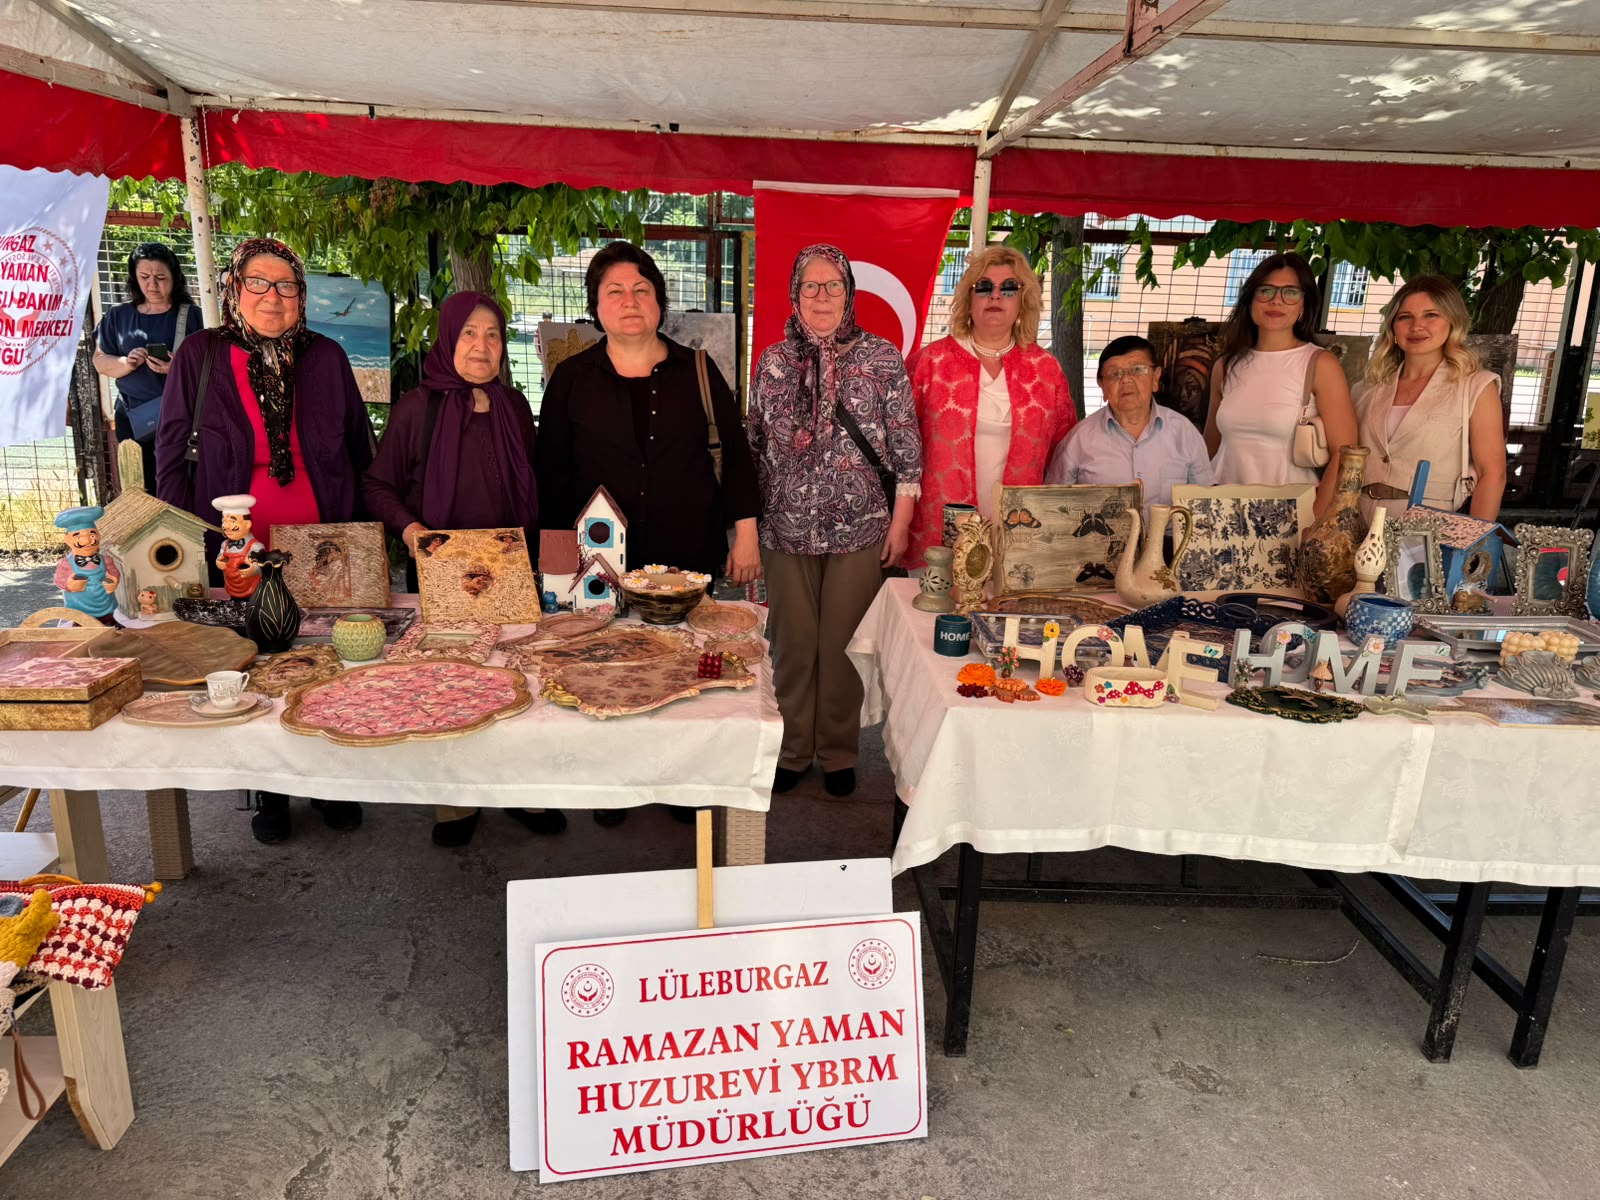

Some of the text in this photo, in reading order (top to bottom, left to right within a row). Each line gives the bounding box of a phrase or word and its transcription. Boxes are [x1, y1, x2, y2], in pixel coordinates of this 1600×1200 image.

[1, 261, 49, 283] YAMAN
[17, 291, 64, 311] BAKIM
[21, 315, 74, 337] MERKEZİ
[940, 631, 971, 642] HOME
[1228, 621, 1451, 704] HOME
[640, 961, 829, 1003] LÜLEBURGAZ
[567, 1009, 905, 1071] RAMAZAN YAMAN
[578, 1054, 899, 1115] HUZUREVİ YBRM
[611, 1093, 871, 1157] MÜDÜRLÜĞÜ
